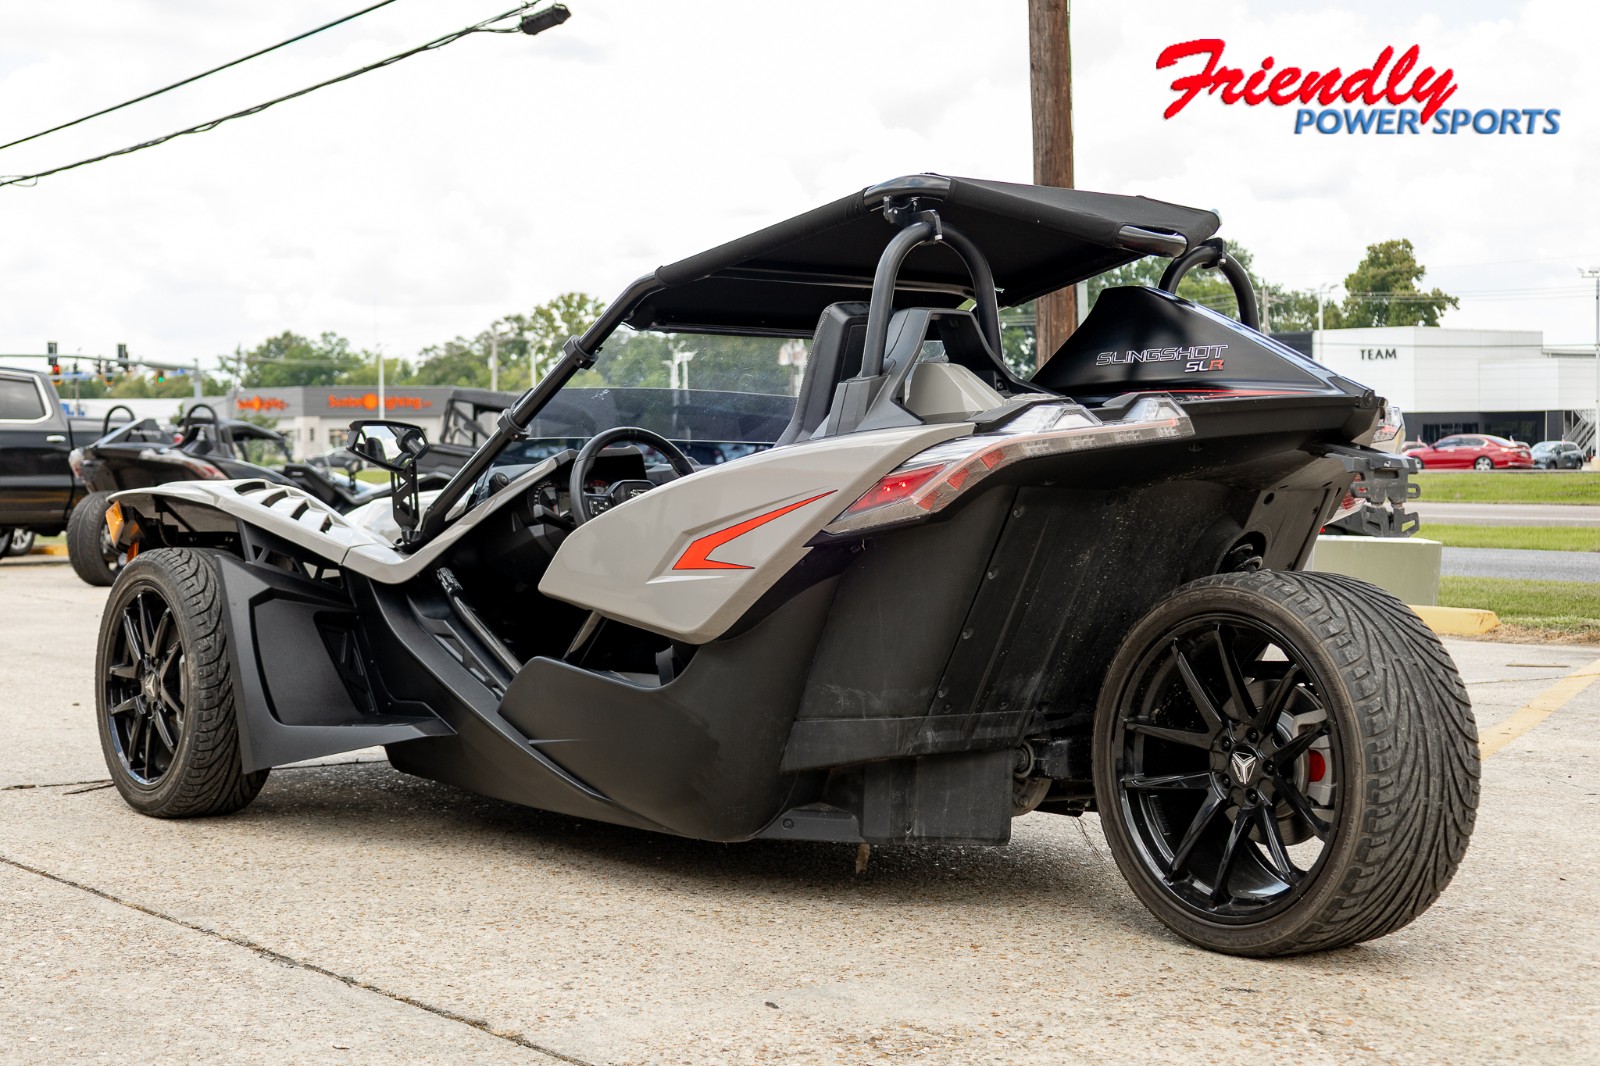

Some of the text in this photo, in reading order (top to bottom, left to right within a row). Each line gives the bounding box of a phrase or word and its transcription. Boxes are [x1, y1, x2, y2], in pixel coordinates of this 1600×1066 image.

[1096, 344, 1229, 365] SLINGSHOT
[1360, 349, 1397, 360] TEAM
[1184, 359, 1225, 373] SLR
